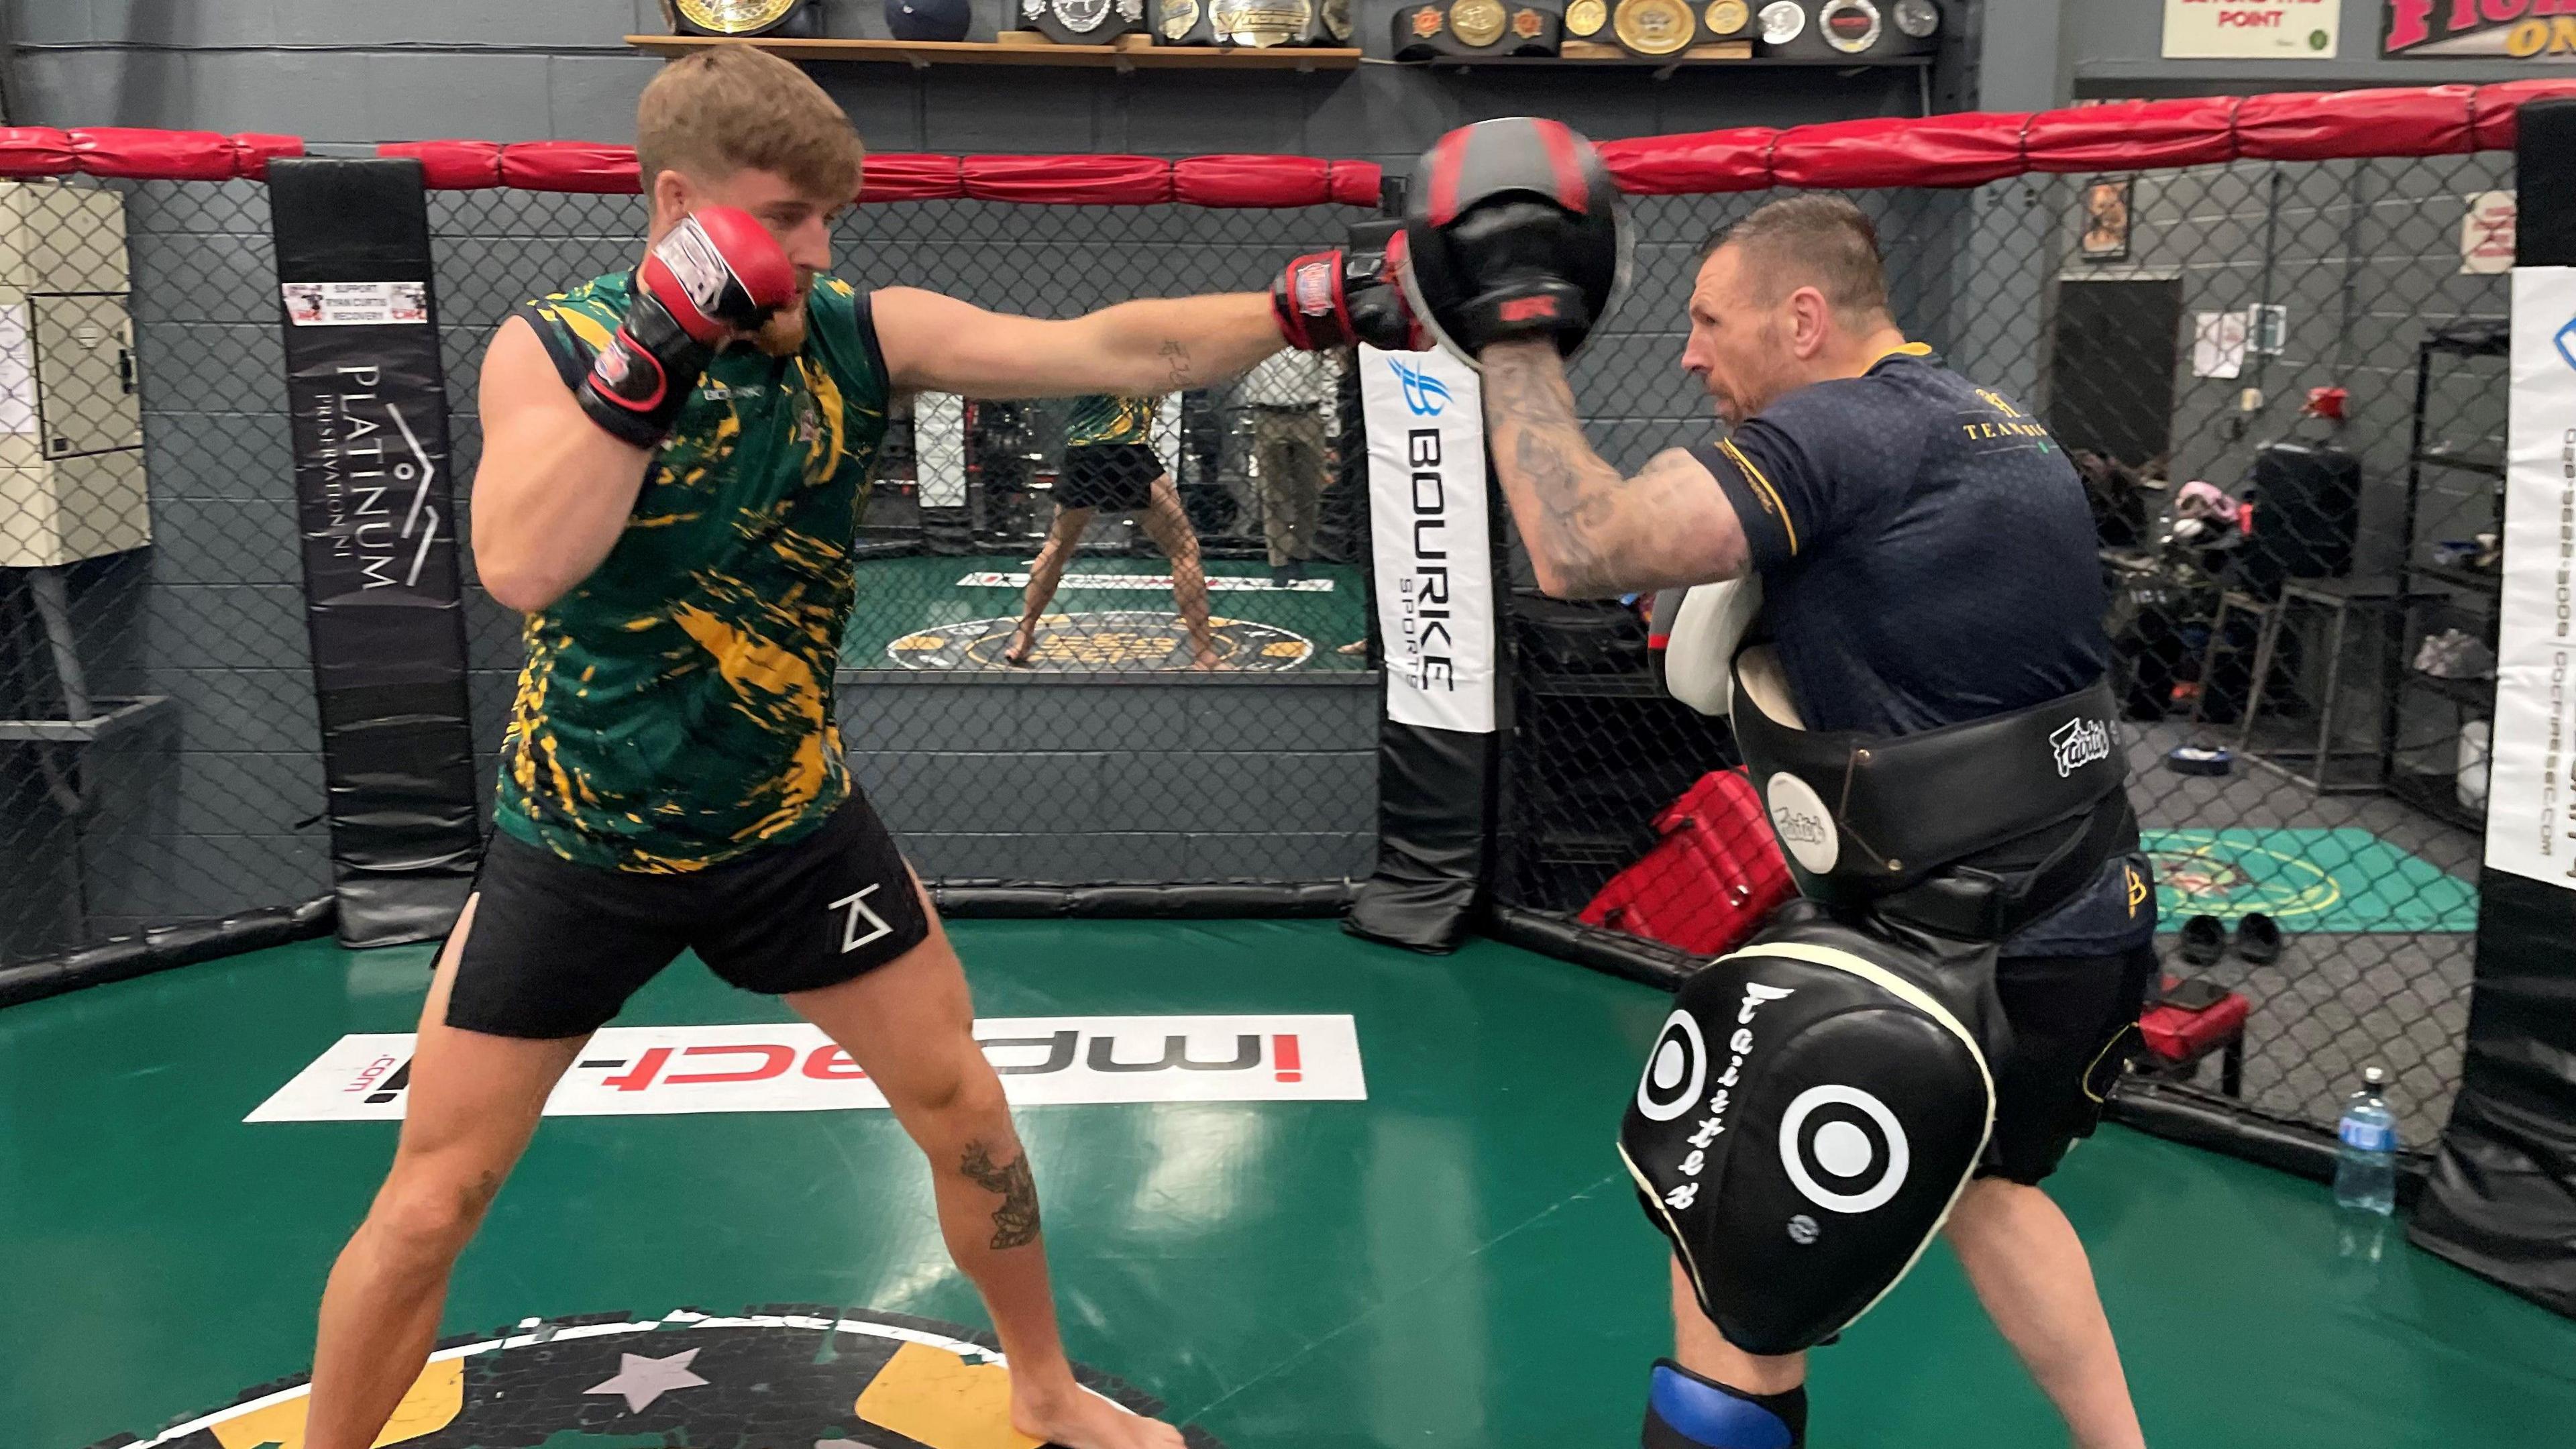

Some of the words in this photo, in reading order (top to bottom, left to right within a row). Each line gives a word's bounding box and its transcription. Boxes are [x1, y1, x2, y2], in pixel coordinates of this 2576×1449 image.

[2218, 11, 2286, 28] POINT
[333, 311, 384, 321] RECOVERY
[334, 284, 378, 293] SUPPORT
[315, 394, 345, 527] PRESERVATION
[333, 535, 354, 557] NI
[336, 366, 398, 590] PLATINUM
[1408, 428, 1454, 692] BOURKE
[1400, 578, 1419, 690] SPORTS
[342, 1053, 396, 1092] .com
[1665, 981, 1796, 1210] Fairtex
